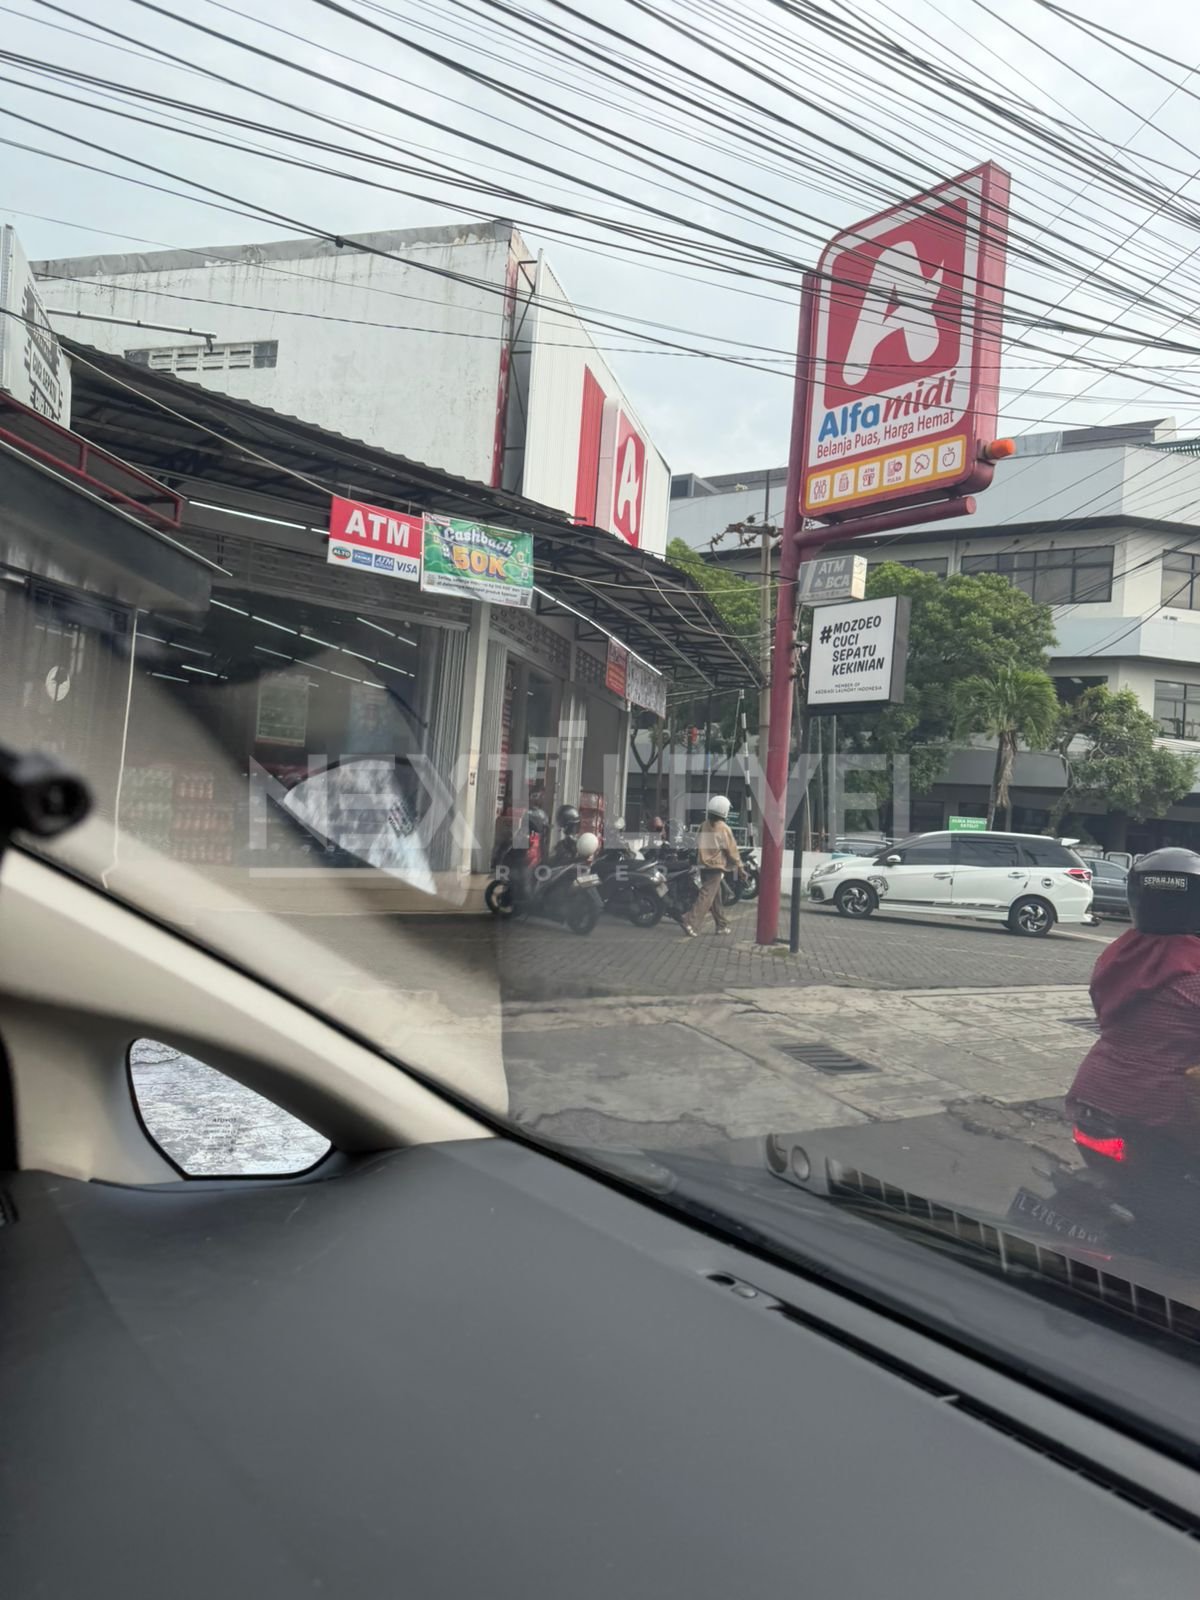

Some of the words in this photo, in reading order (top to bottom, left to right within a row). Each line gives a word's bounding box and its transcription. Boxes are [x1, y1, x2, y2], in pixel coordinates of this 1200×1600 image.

[818, 370, 957, 442] Alfamidi
[817, 437, 852, 459] Belanja
[854, 432, 881, 450] Puas,
[883, 424, 914, 441] Harga
[917, 410, 955, 431] Hemat
[345, 508, 411, 549] ATM
[443, 526, 514, 555] Cashback
[333, 548, 351, 558] ALTO
[452, 544, 507, 578] 50K
[396, 560, 418, 575] VISA
[818, 559, 847, 575] ATM
[825, 574, 850, 589] BCA
[832, 633, 859, 649] CUCI
[832, 644, 877, 662] SEPATU
[831, 657, 885, 676] KEKINIAN
